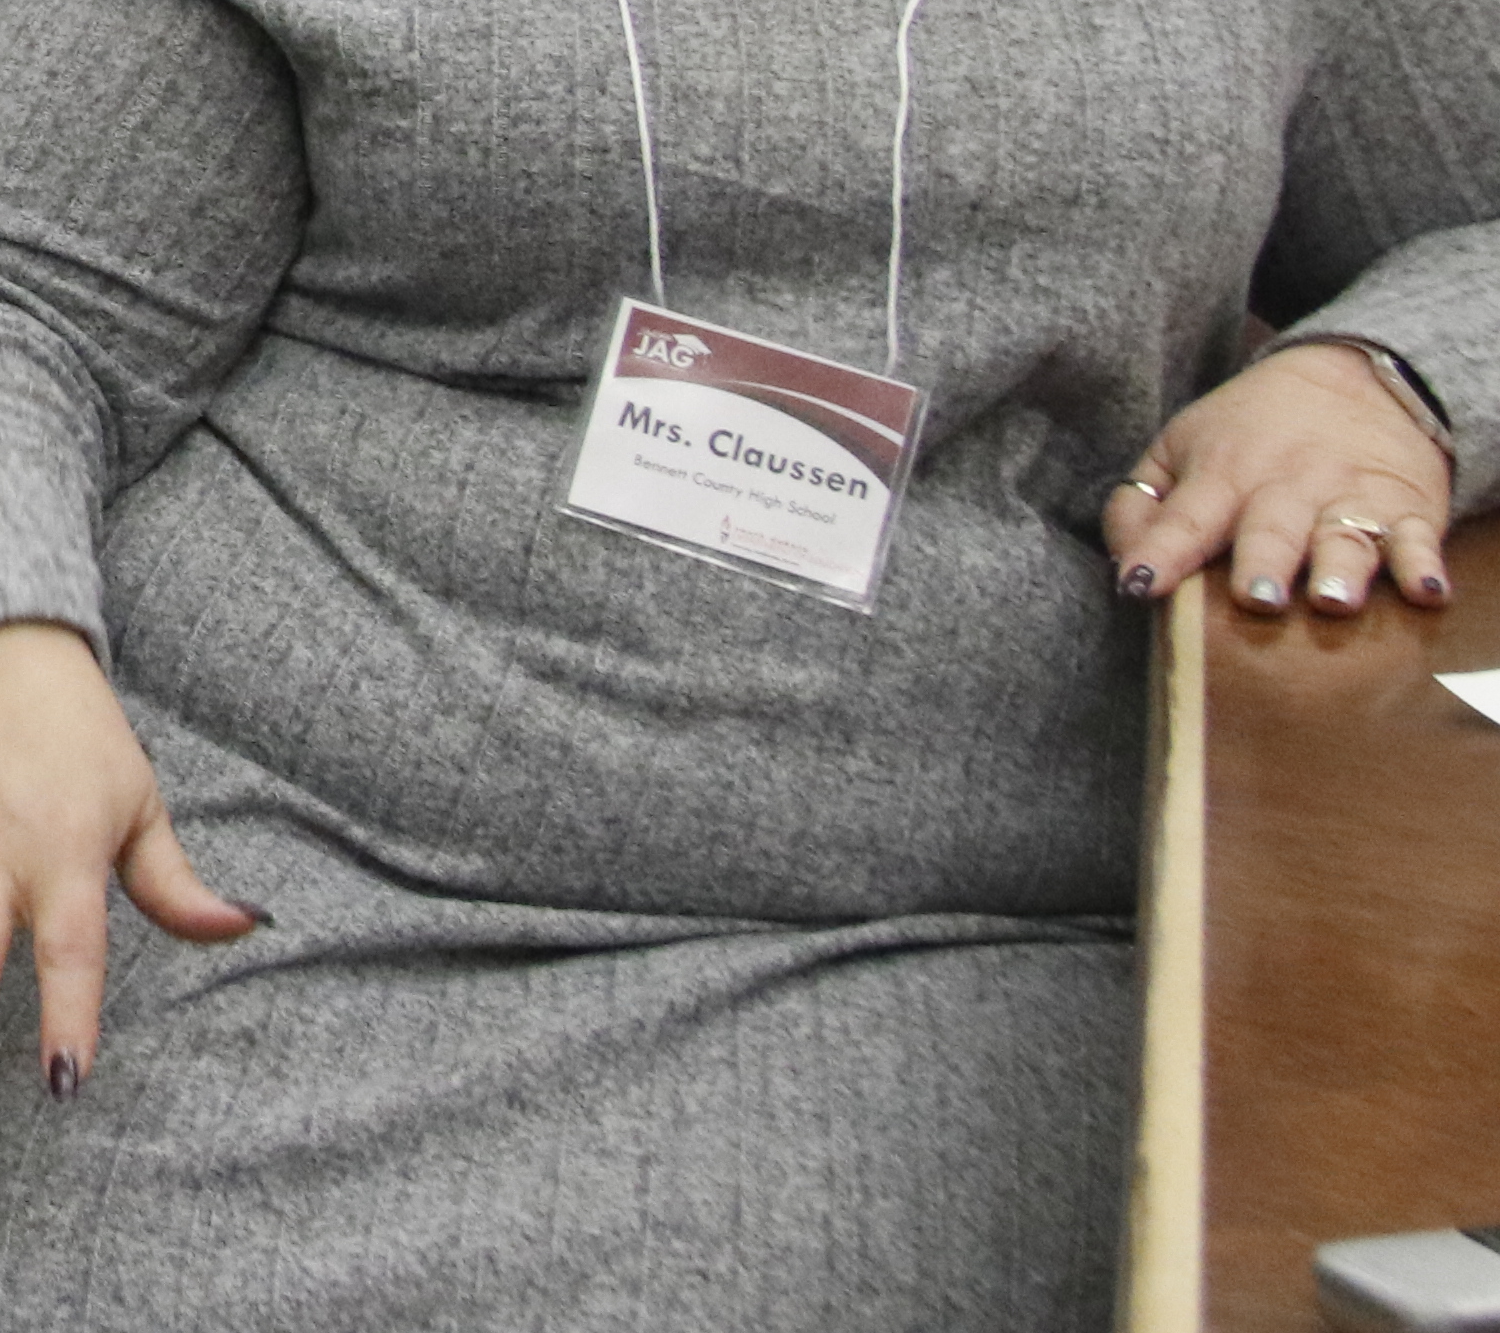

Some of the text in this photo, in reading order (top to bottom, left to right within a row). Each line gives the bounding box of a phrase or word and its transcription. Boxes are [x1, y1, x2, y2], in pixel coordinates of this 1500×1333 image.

[633, 335, 694, 368] JAG
[618, 401, 868, 500] Mrs. Claussen
[634, 453, 836, 526] Bennett County High School
